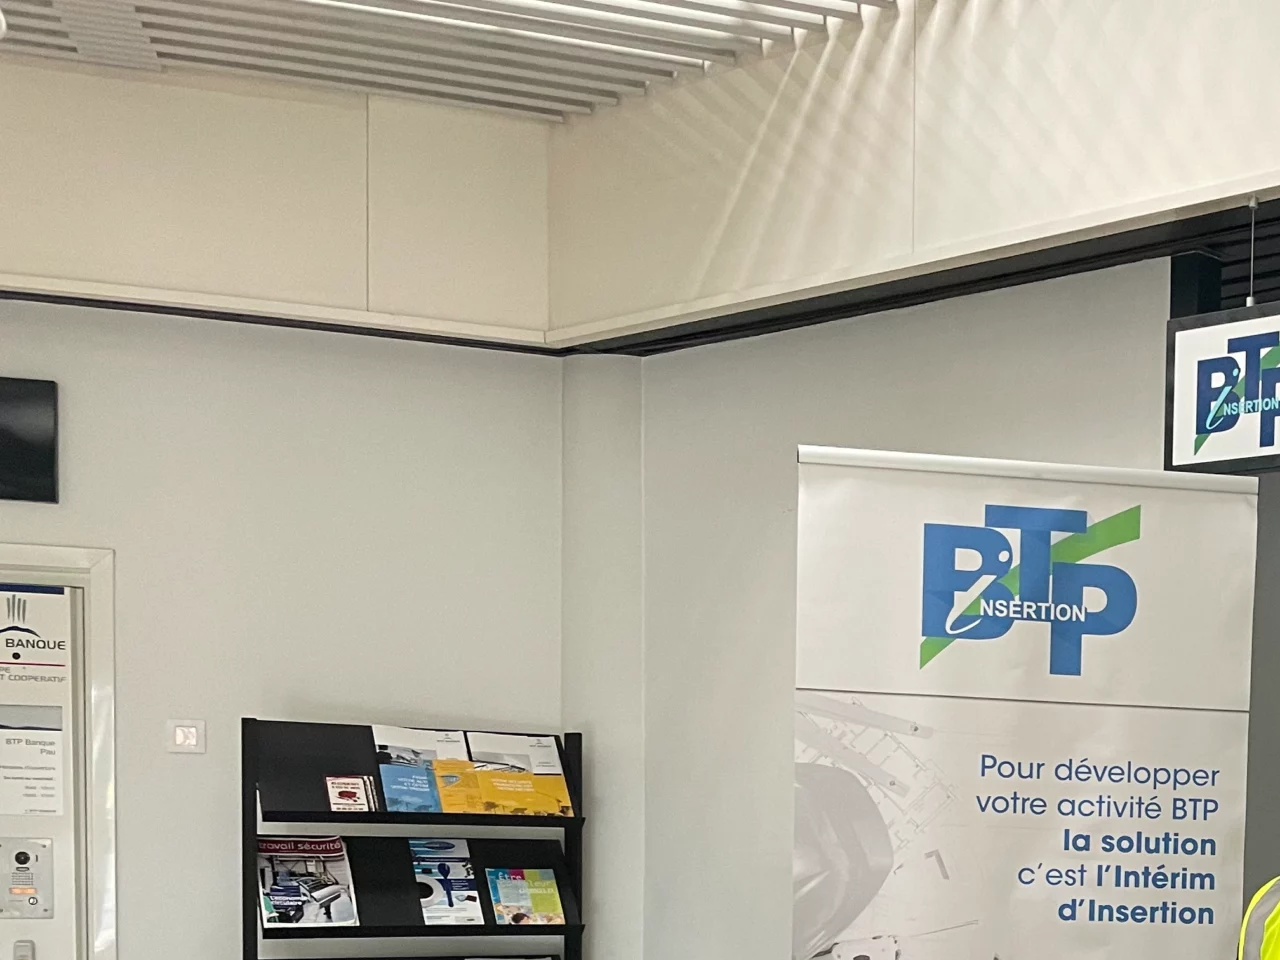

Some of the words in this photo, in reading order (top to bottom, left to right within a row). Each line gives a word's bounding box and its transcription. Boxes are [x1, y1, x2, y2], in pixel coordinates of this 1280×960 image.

[5, 638, 66, 650] BANQUE
[980, 754, 1045, 780] Pour
[1054, 757, 1220, 790] développer
[976, 793, 1047, 815] votre
[1056, 796, 1161, 820] activité
[1171, 798, 1218, 821] BTP
[1063, 829, 1090, 852] la
[1101, 831, 1217, 856] solution
[1017, 864, 1087, 887] c'est
[1096, 864, 1216, 891] l'Intérim
[1058, 899, 1215, 925] d'Insertion
